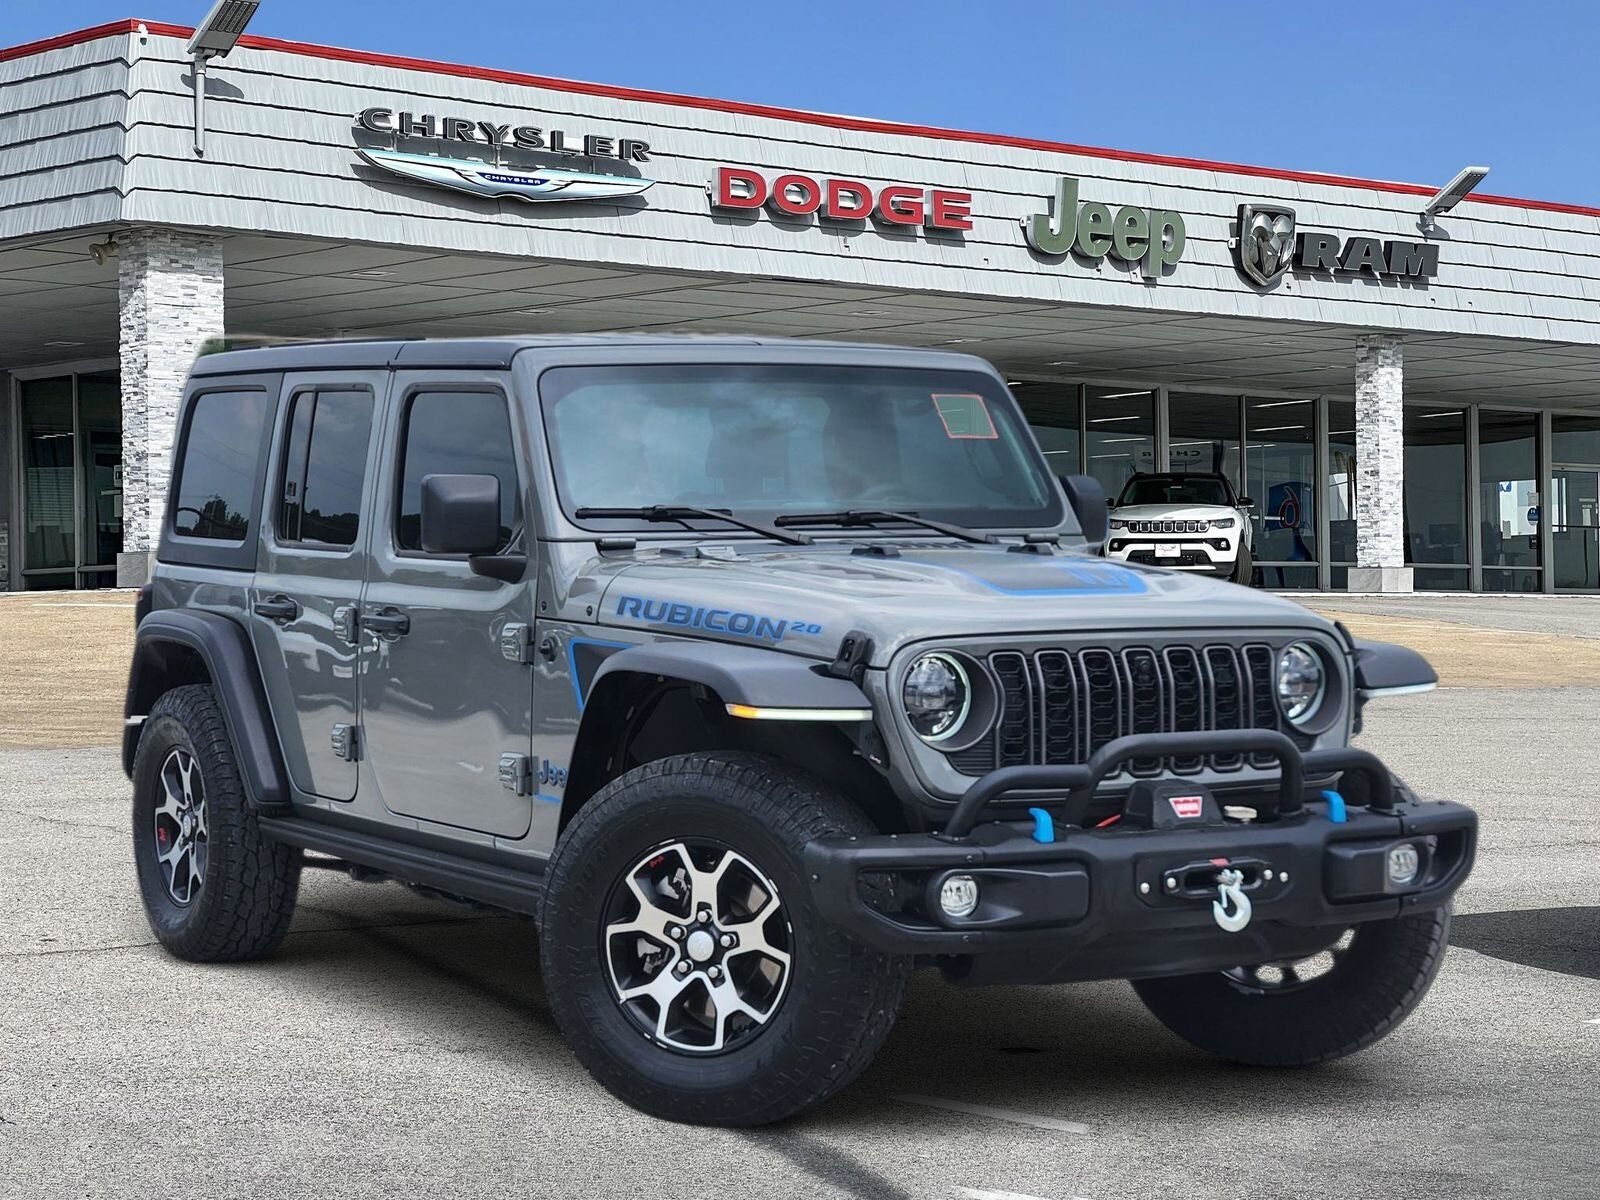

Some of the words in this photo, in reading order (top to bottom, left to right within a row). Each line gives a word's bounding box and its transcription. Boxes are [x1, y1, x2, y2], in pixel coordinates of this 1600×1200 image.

[356, 106, 650, 163] CHRYSLER
[484, 174, 541, 185] CHRYSLER
[713, 166, 974, 231] DODGE
[1024, 177, 1186, 278] Jeep
[1298, 232, 1440, 278] RAM
[616, 596, 787, 640] RUBICON
[539, 759, 568, 788] Jee
